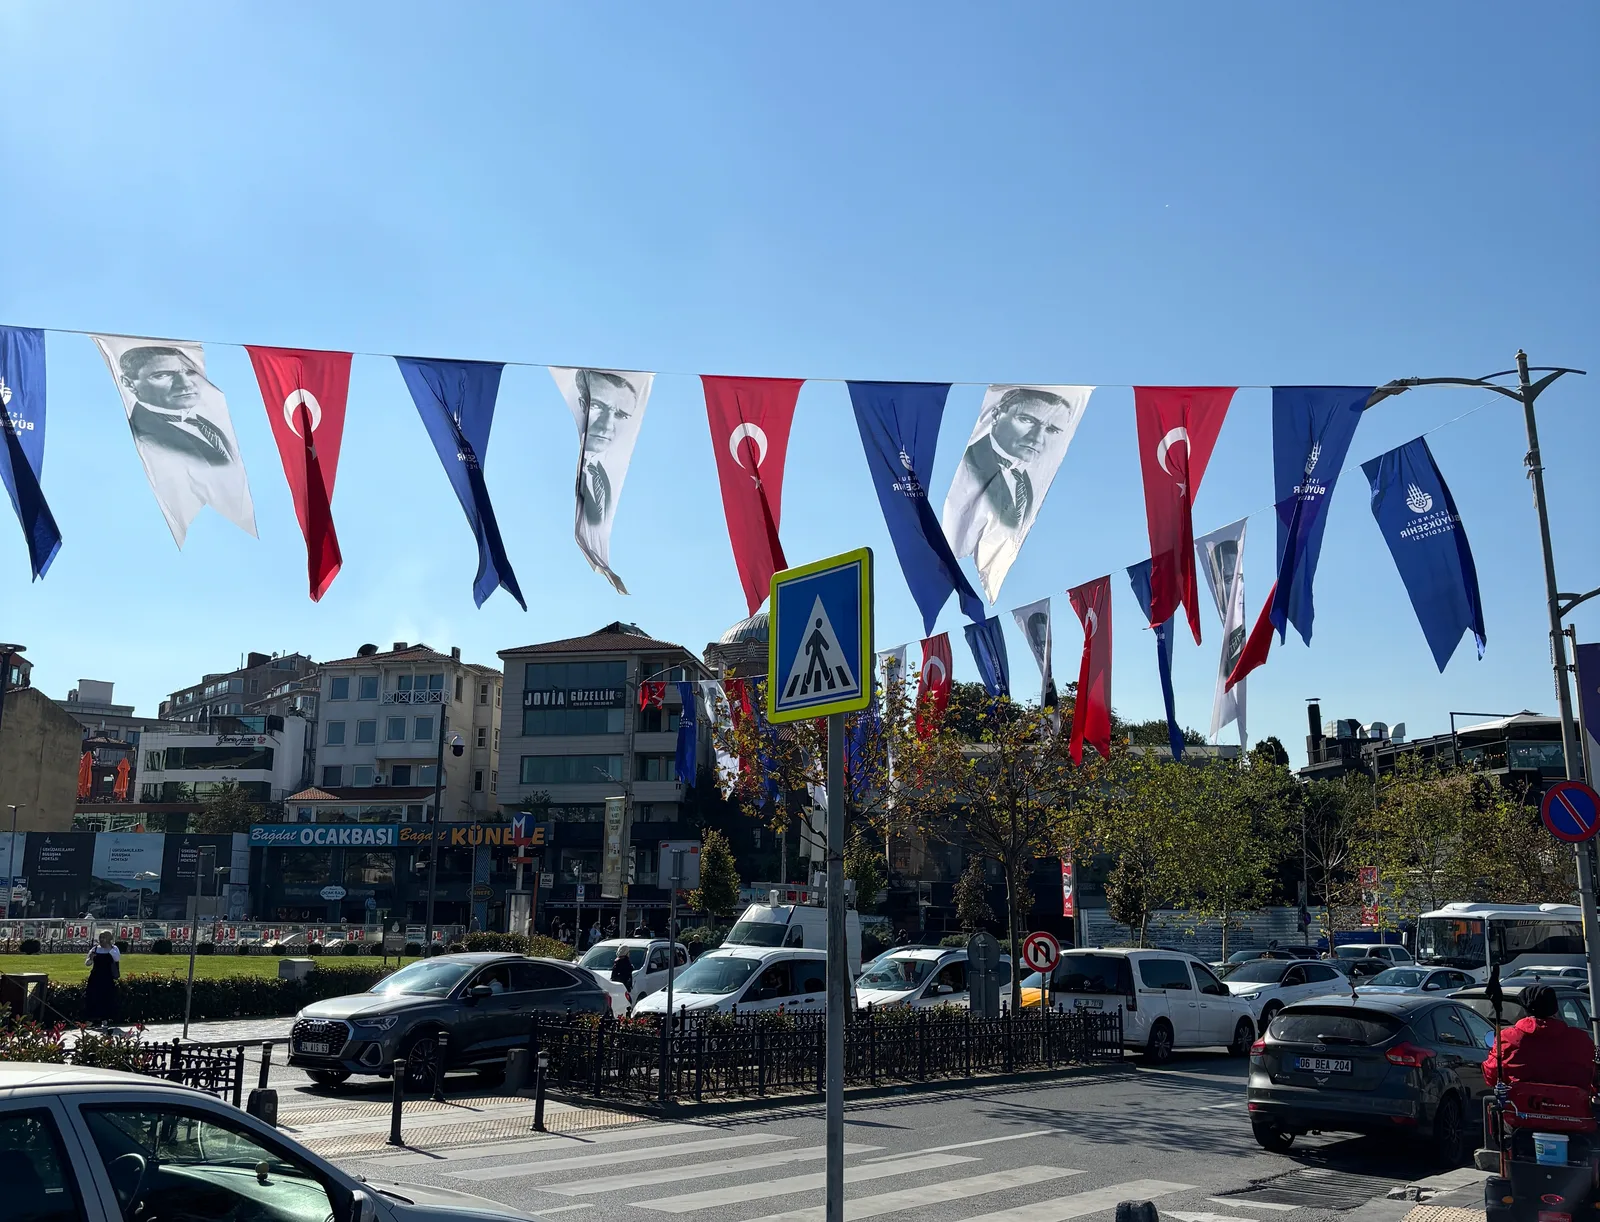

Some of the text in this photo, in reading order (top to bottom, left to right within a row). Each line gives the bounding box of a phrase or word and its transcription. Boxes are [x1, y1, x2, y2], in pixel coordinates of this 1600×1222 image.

[524, 688, 615, 706] JOVİA GÜZELLİK
[251, 828, 393, 845] Bağdat OCAKBAŞI
[400, 825, 545, 845] Bağdt KÜNEE
[1300, 1058, 1350, 1071] 06 BEA 204
